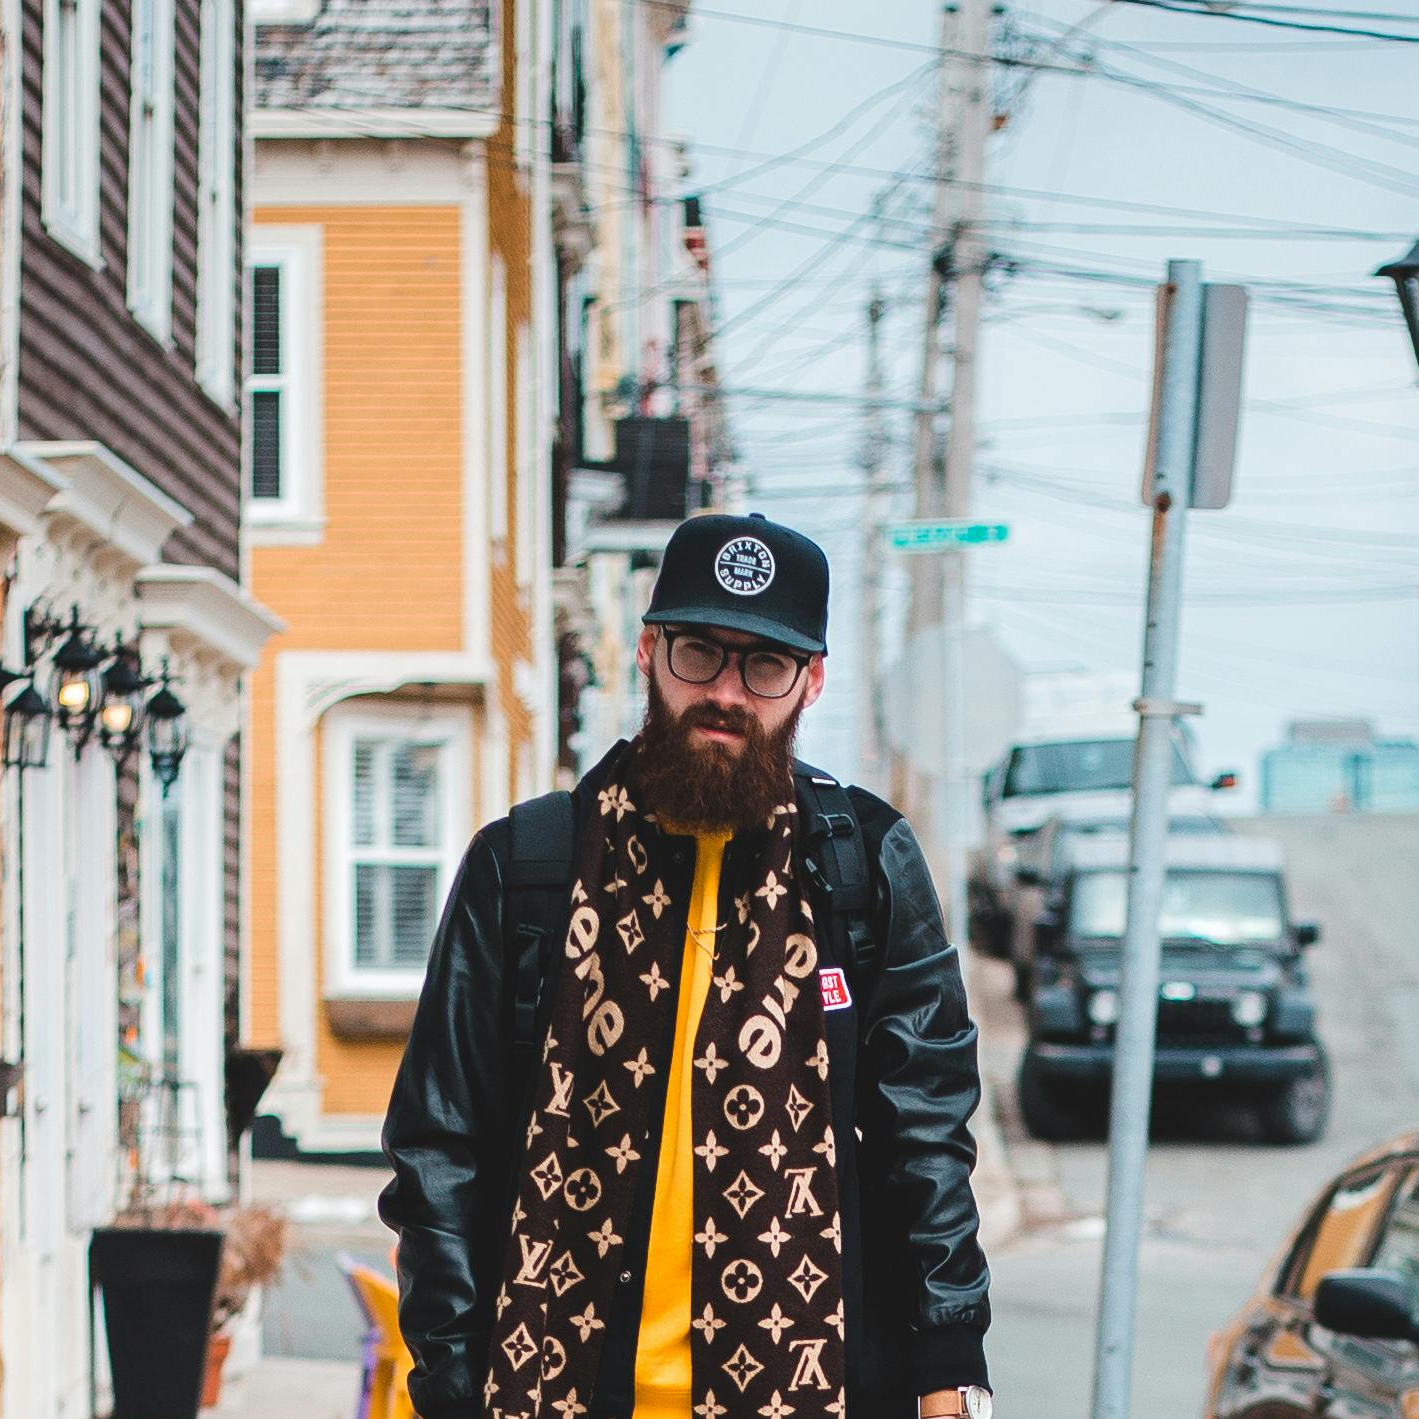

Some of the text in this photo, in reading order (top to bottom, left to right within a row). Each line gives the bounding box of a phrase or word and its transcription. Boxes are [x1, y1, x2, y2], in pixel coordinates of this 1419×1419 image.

[722, 542, 770, 568] BRIXTON
[736, 554, 756, 565] TRADE
[720, 567, 766, 591] SUPPLY
[734, 567, 753, 578] MARK
